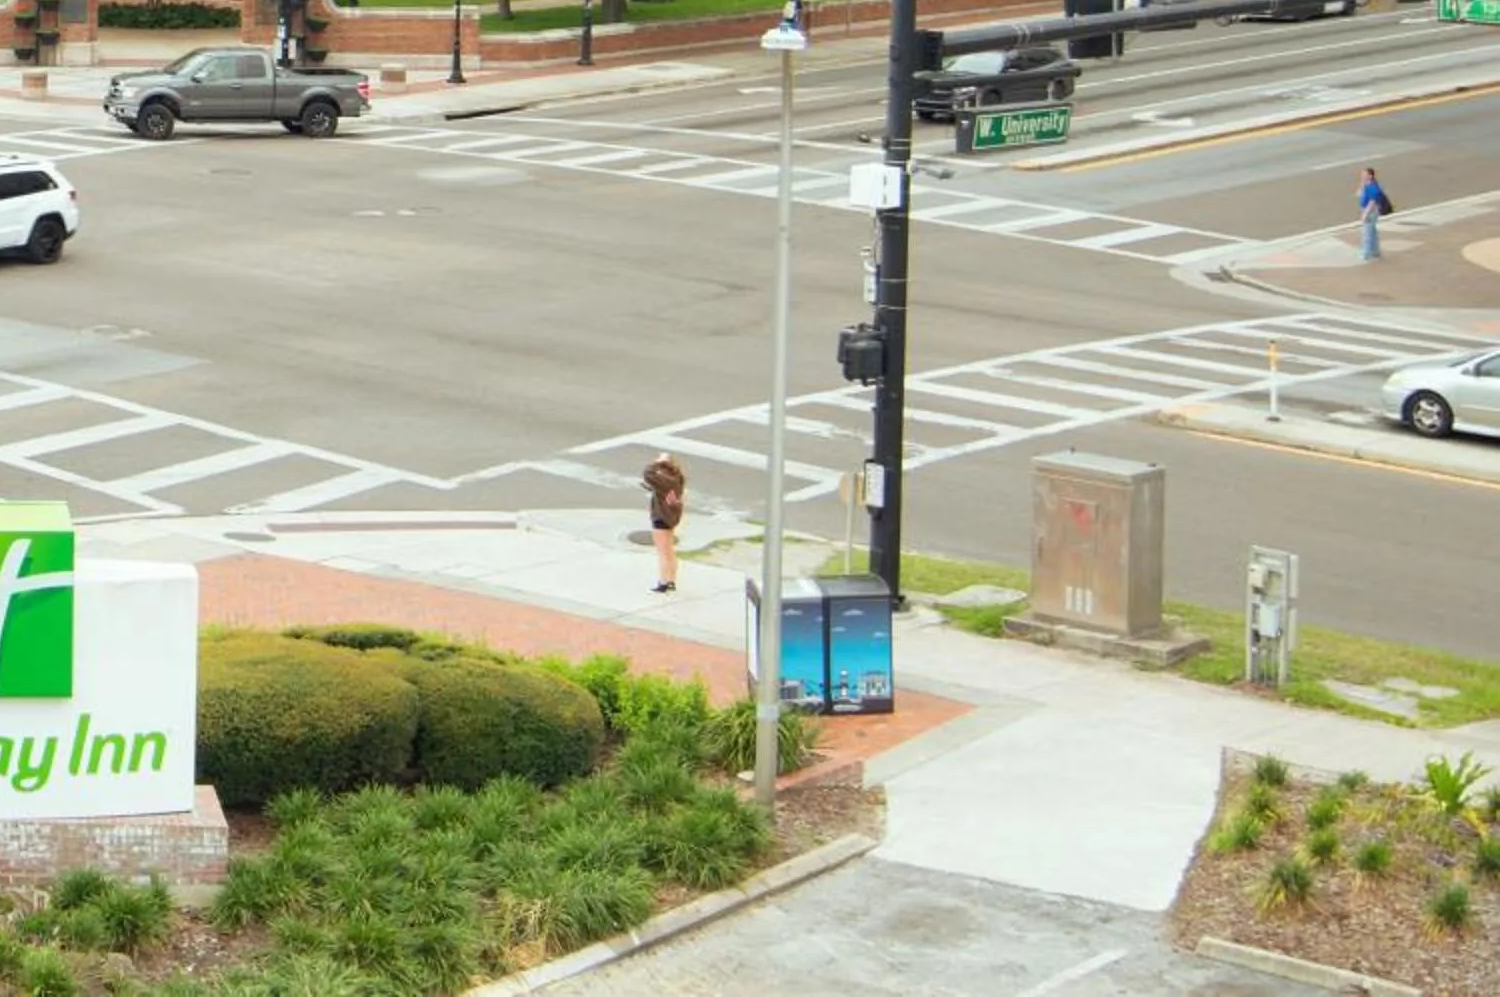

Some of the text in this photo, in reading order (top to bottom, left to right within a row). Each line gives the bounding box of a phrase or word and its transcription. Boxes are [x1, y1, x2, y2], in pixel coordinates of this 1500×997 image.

[979, 111, 1066, 138] W. University
[68, 713, 167, 777] Inn
